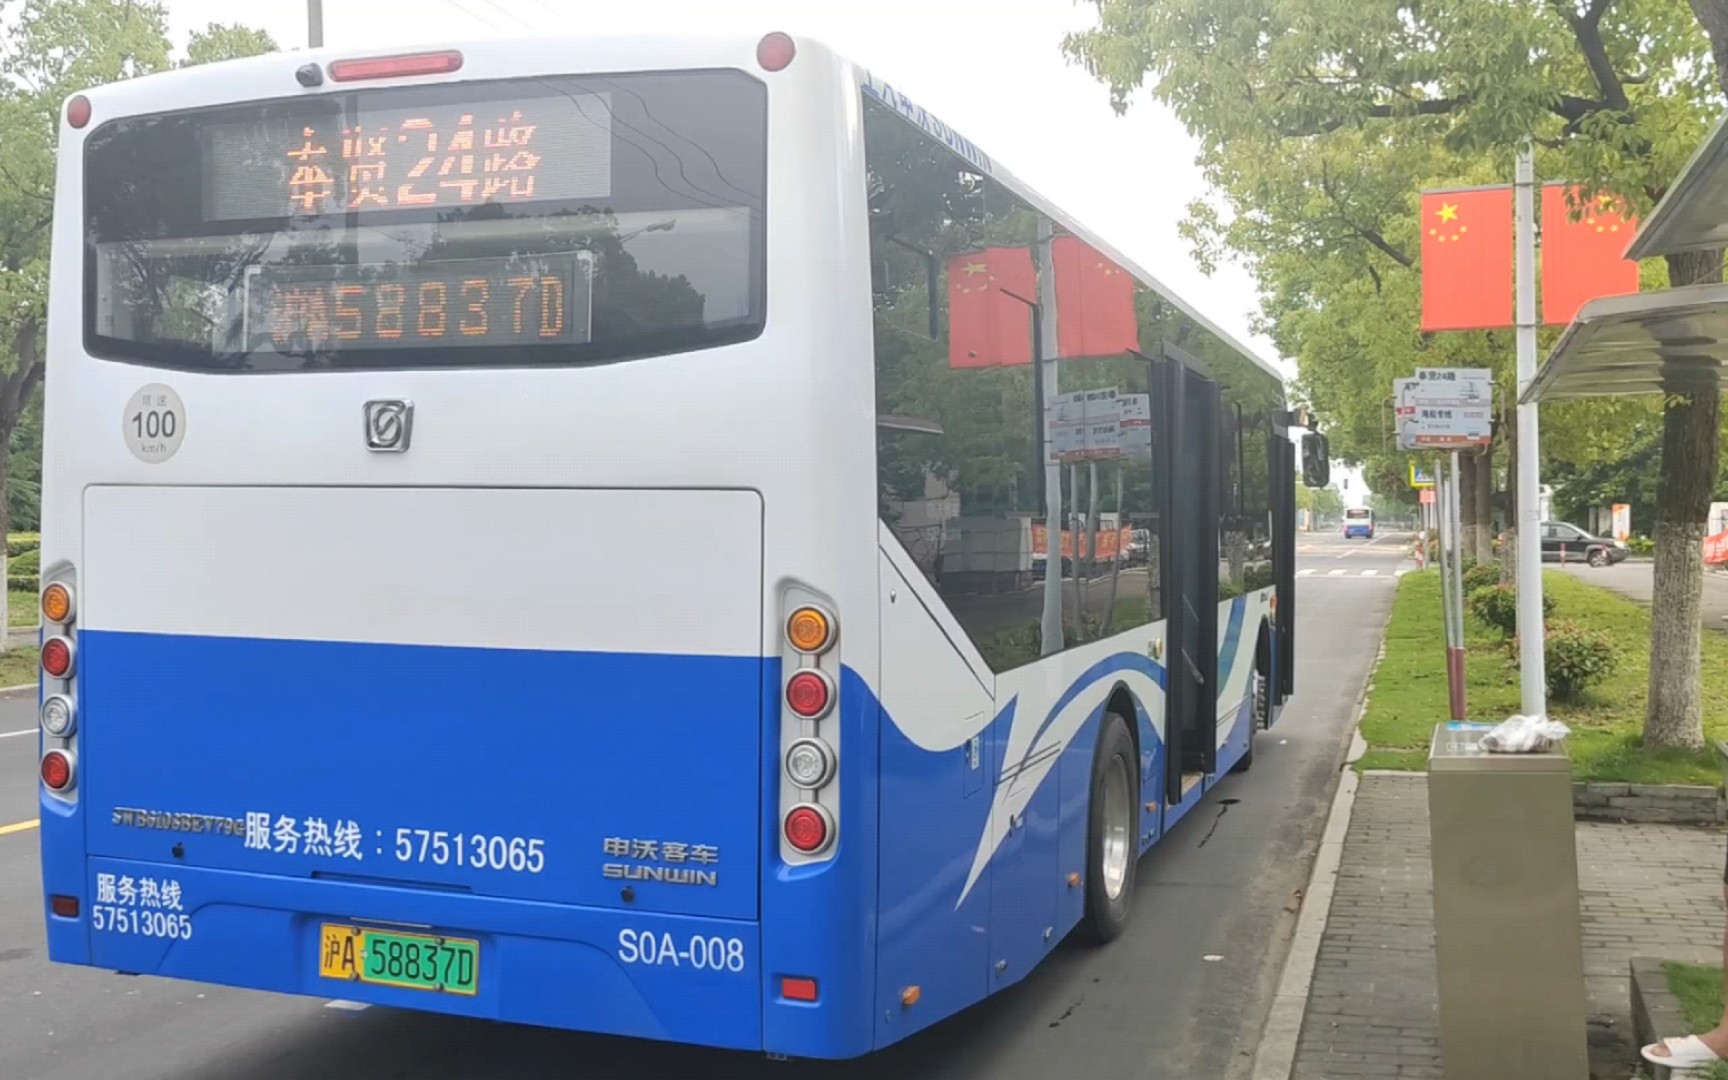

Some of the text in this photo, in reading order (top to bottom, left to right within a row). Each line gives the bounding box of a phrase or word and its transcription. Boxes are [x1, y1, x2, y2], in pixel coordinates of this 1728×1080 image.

[287, 110, 541, 212] 奉贤24路
[132, 410, 176, 438] 100
[603, 837, 719, 865] 申沃客车
[602, 863, 717, 886] SUNWIN
[97, 872, 183, 911] 服务热线
[93, 905, 192, 939] 57513065
